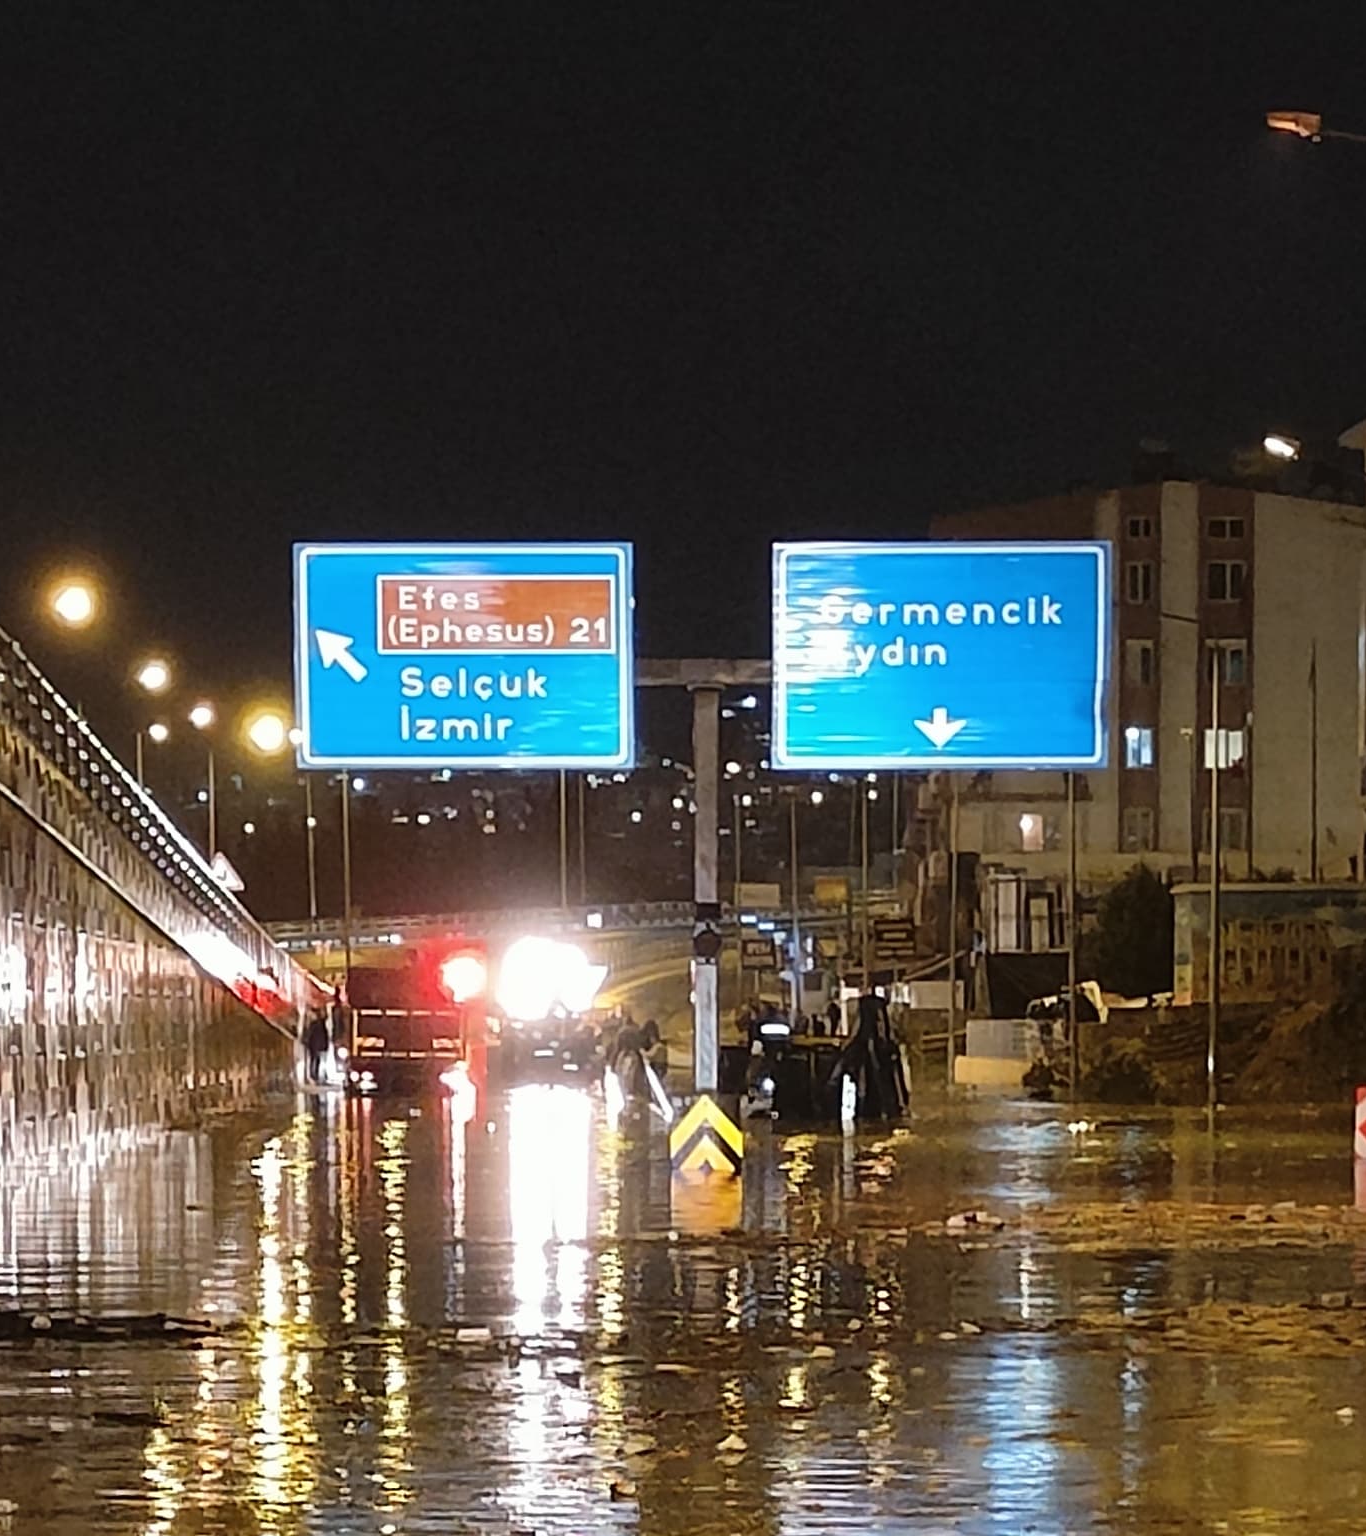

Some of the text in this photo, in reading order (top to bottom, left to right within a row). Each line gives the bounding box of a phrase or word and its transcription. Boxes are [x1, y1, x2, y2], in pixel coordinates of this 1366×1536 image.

[398, 585, 480, 611] Efes
[387, 615, 607, 648] (Ephesus) 21
[825, 636, 948, 677] ydın
[400, 667, 548, 701] Selçuk
[401, 704, 514, 741] İzmir
